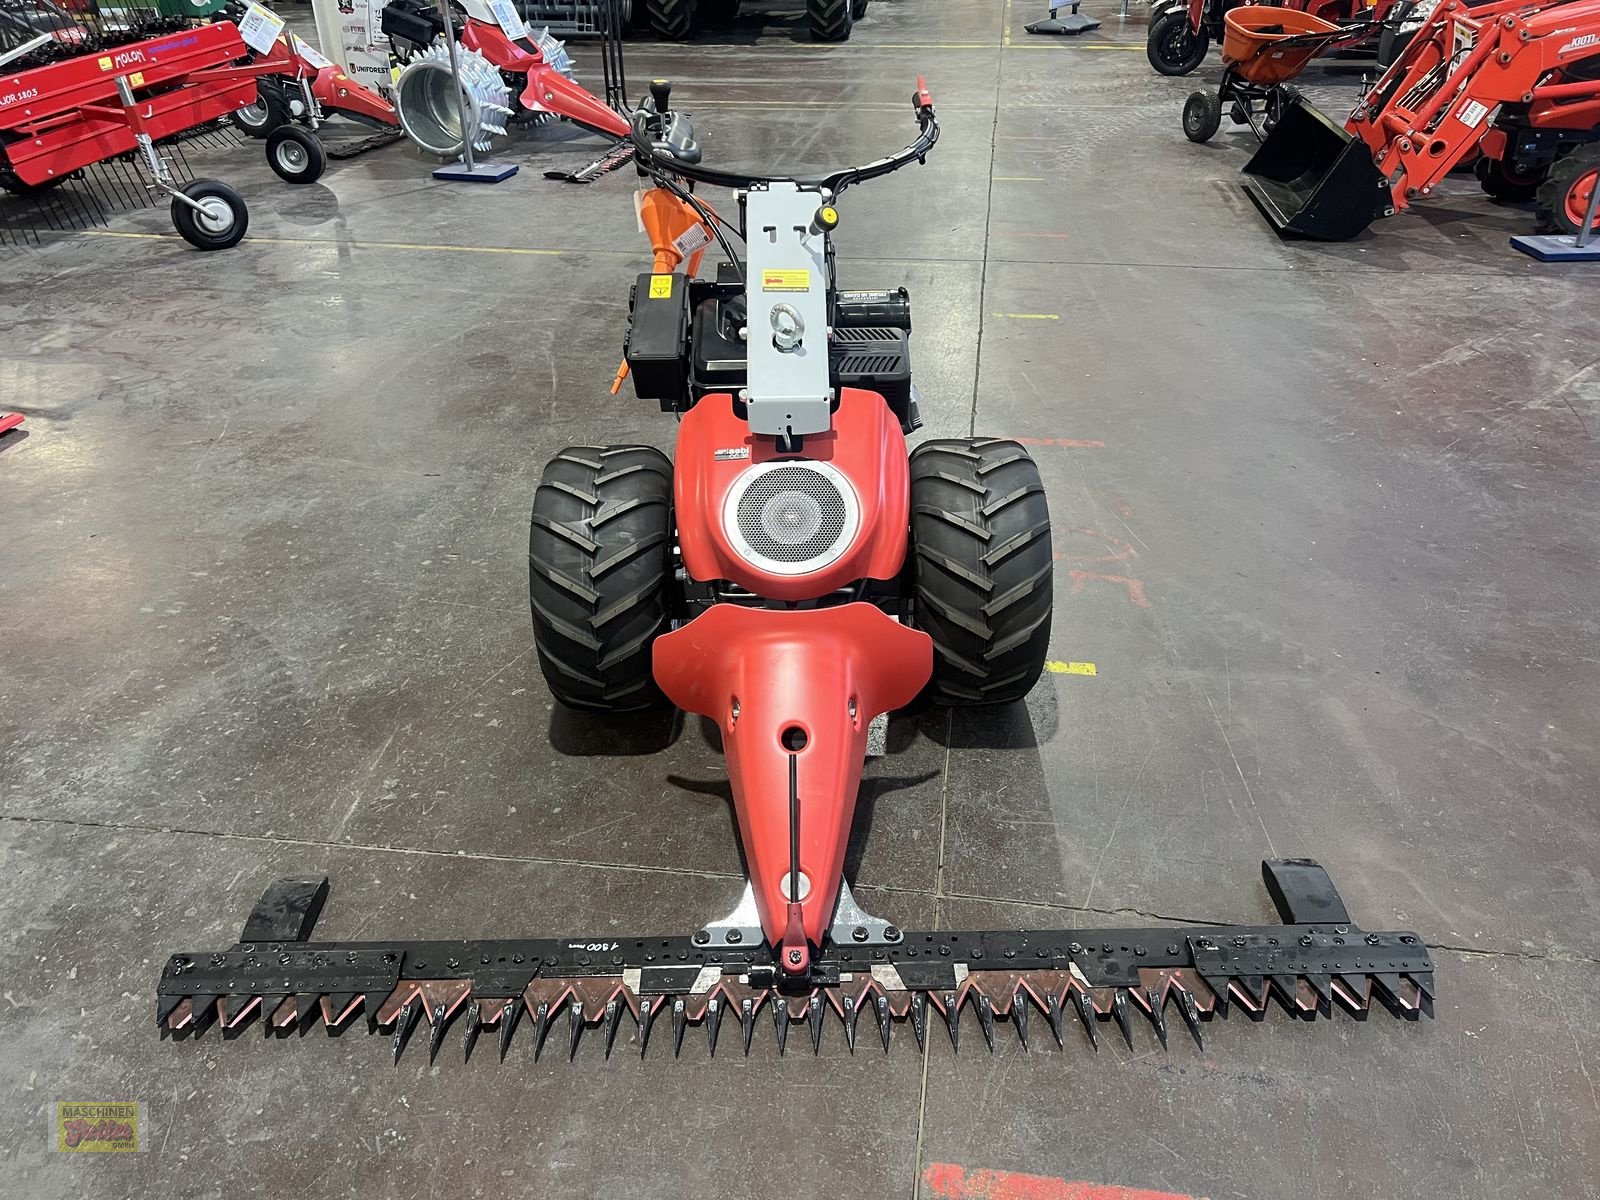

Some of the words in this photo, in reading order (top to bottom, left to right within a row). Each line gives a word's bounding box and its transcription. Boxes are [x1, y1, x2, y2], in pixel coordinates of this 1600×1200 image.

[1571, 33, 1596, 47] KIOTI
[114, 49, 146, 69] MOLON
[356, 66, 389, 74] UNIFOREST
[0, 93, 18, 106] JOR
[17, 88, 38, 101] 1803
